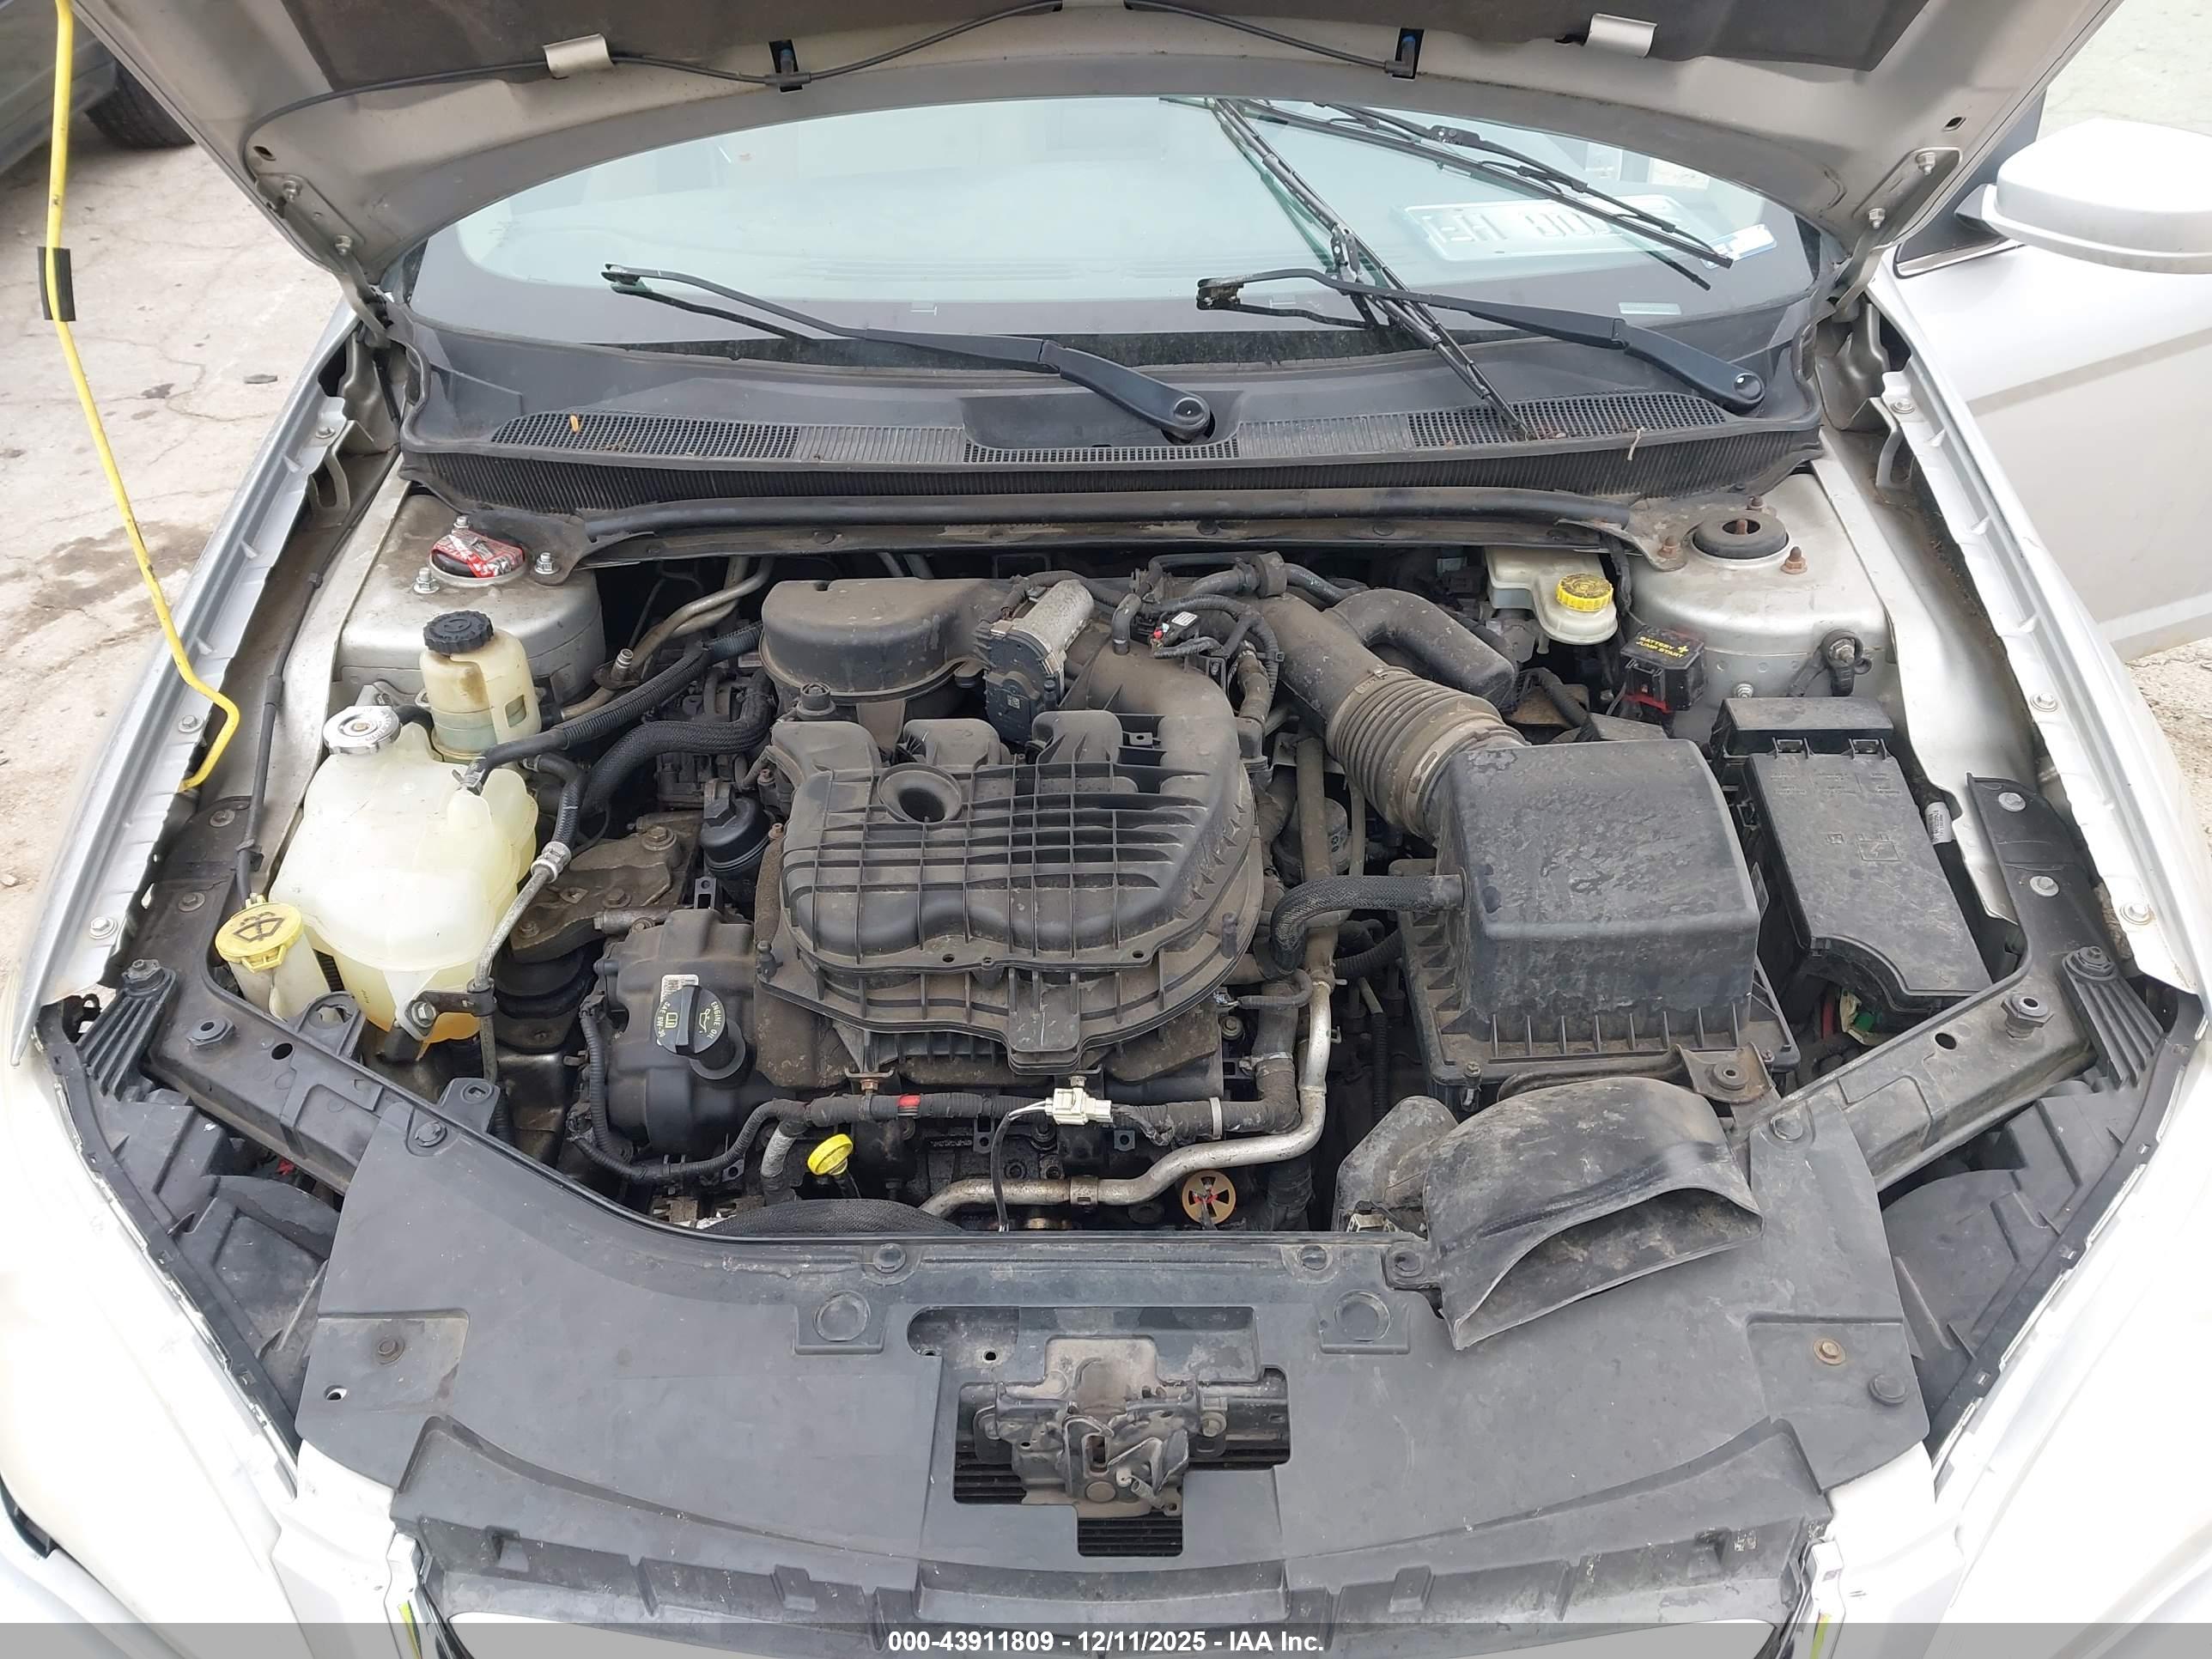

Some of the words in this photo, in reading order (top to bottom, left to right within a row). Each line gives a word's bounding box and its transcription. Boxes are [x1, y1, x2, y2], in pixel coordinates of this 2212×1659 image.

[1636, 641, 1658, 650] JUMP
[1657, 647, 1684, 659] START
[1639, 636, 1674, 650] BATTERY
[659, 1001, 671, 1014] SAE
[711, 1001, 721, 1026] ENGINE
[706, 1029, 717, 1039] OIL
